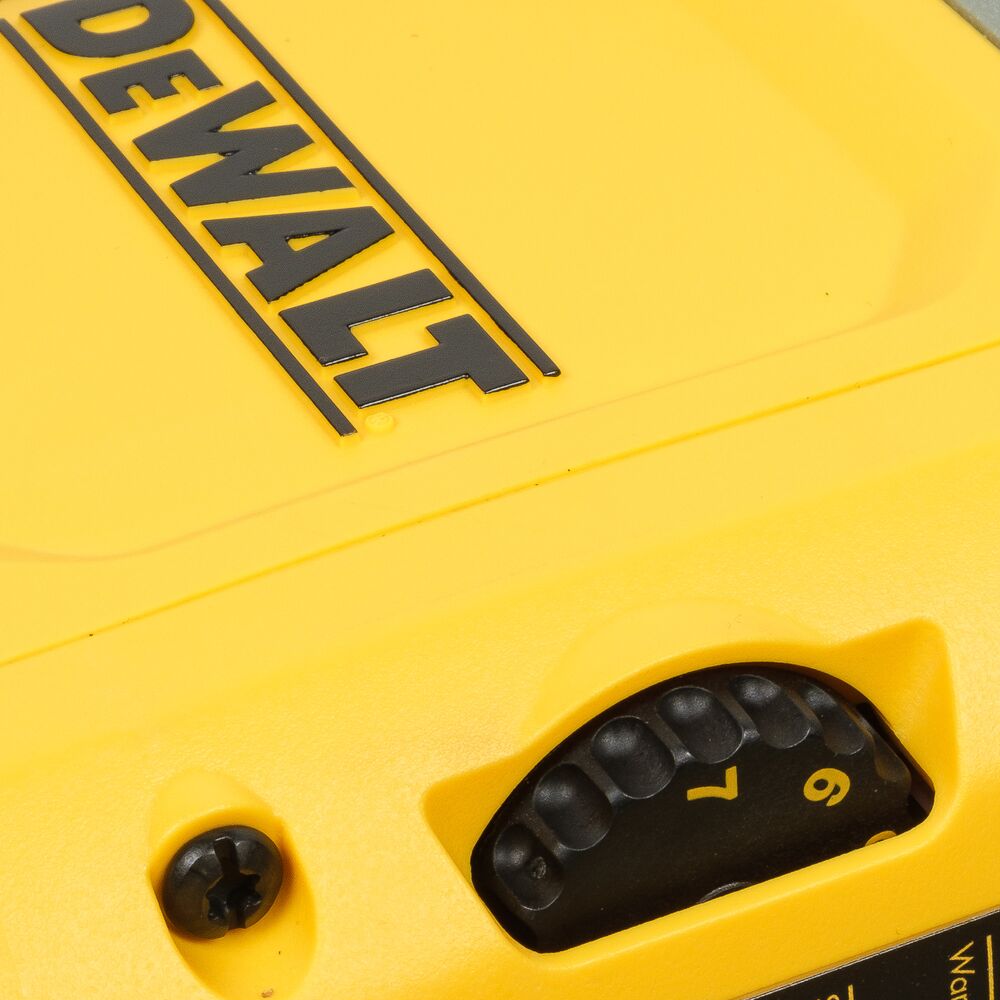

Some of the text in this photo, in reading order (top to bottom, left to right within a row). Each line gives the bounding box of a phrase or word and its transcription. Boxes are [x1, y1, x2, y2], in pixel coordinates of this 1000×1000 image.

[19, 0, 529, 408] DEWALT
[687, 766, 738, 801] 7
[803, 767, 851, 807] 6
